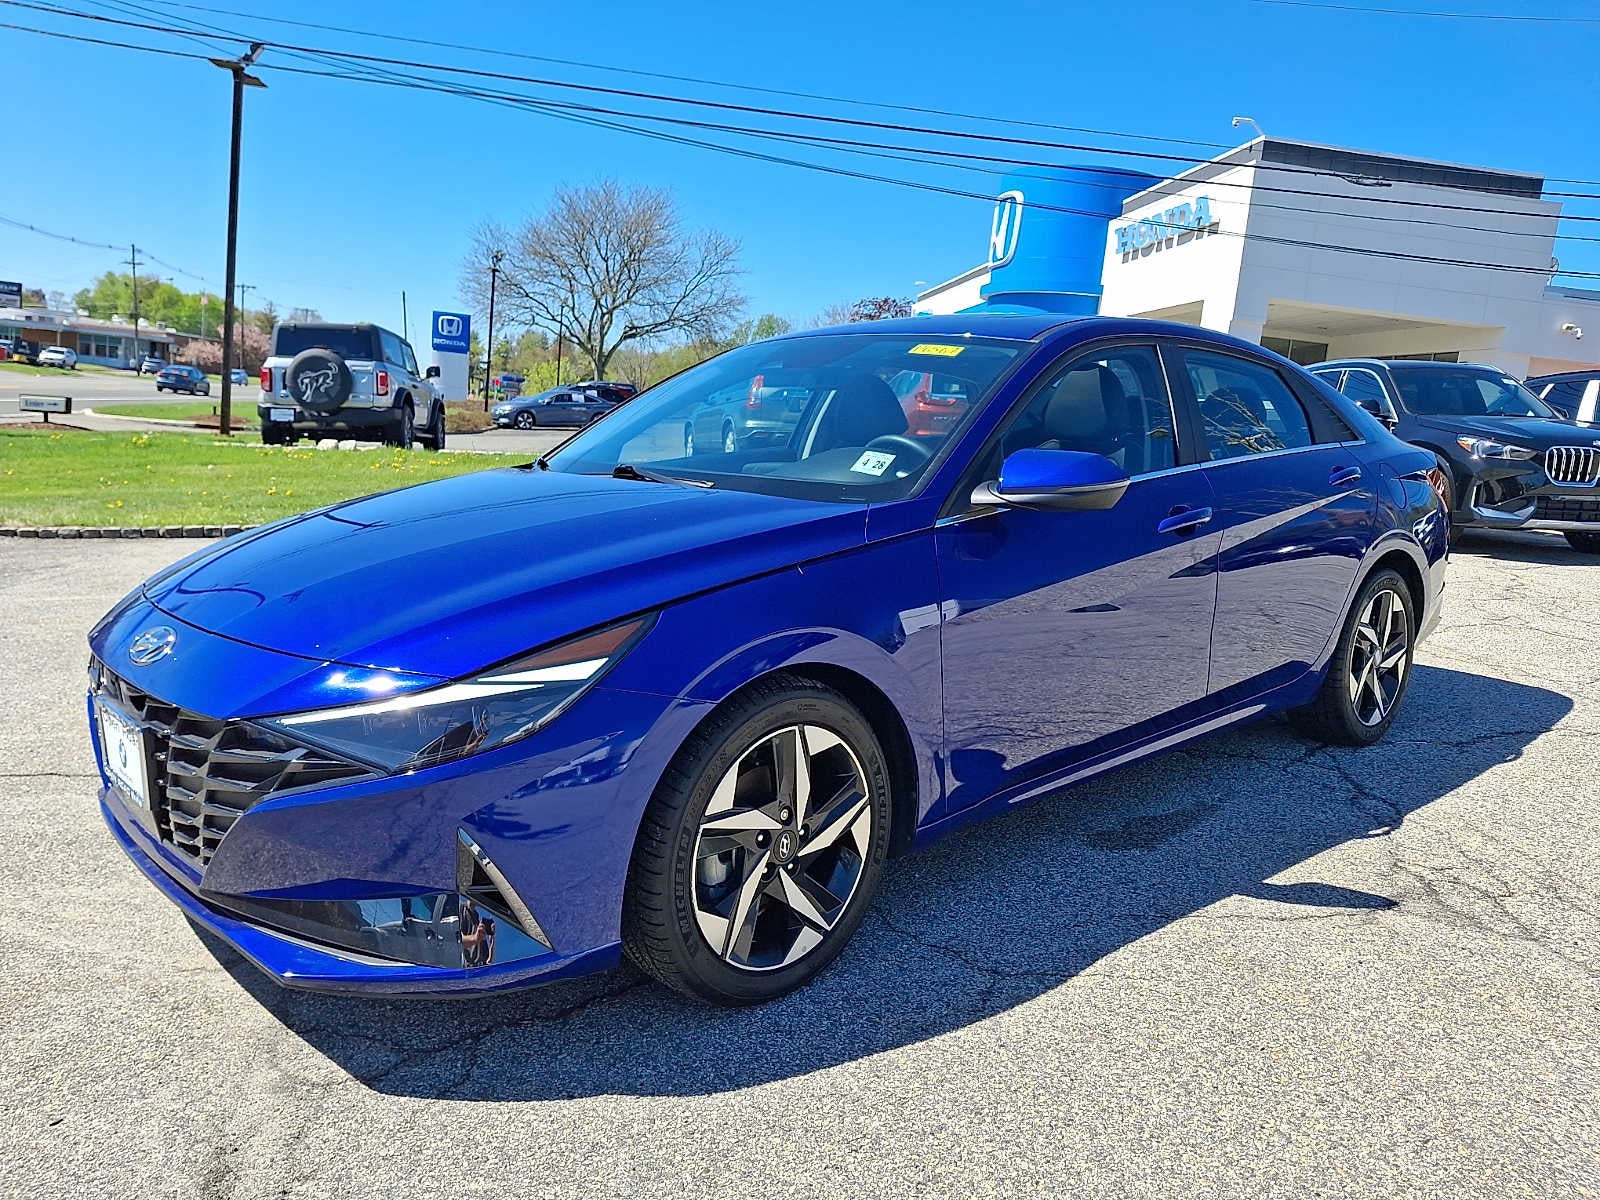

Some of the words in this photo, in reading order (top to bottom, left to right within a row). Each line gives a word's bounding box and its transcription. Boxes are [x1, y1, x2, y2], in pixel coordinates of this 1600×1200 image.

[1115, 195, 1213, 255] HONDA
[433, 337, 467, 347] HONDA
[872, 460, 886, 470] 28
[674, 826, 692, 936] MICHELIN
